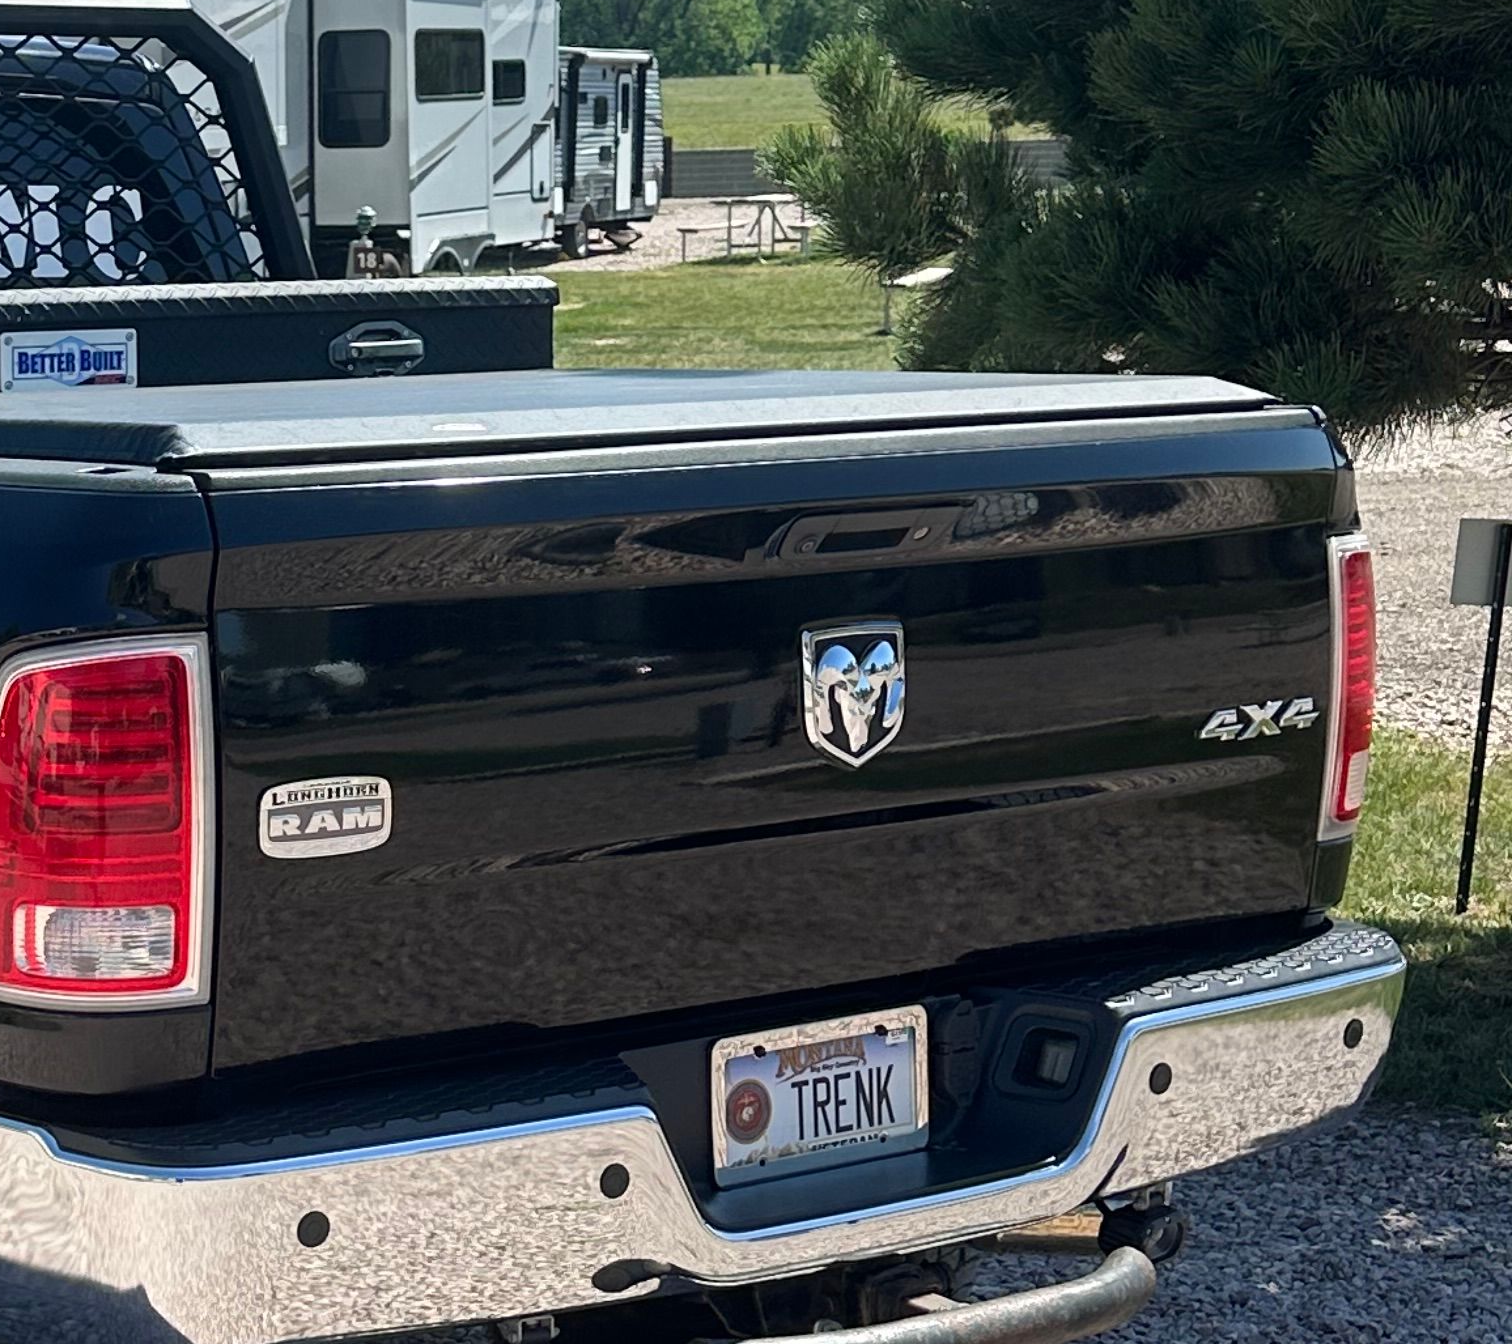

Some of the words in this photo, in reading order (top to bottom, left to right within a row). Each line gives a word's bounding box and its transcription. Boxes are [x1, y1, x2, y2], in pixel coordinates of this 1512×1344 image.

[357, 252, 377, 269] 18
[18, 351, 76, 374] BETTER
[80, 350, 124, 371] BUILT
[272, 784, 379, 804] LONGHORN
[269, 806, 382, 837] RAM
[777, 1037, 867, 1077] MONTANA
[791, 1064, 895, 1140] TRENK
